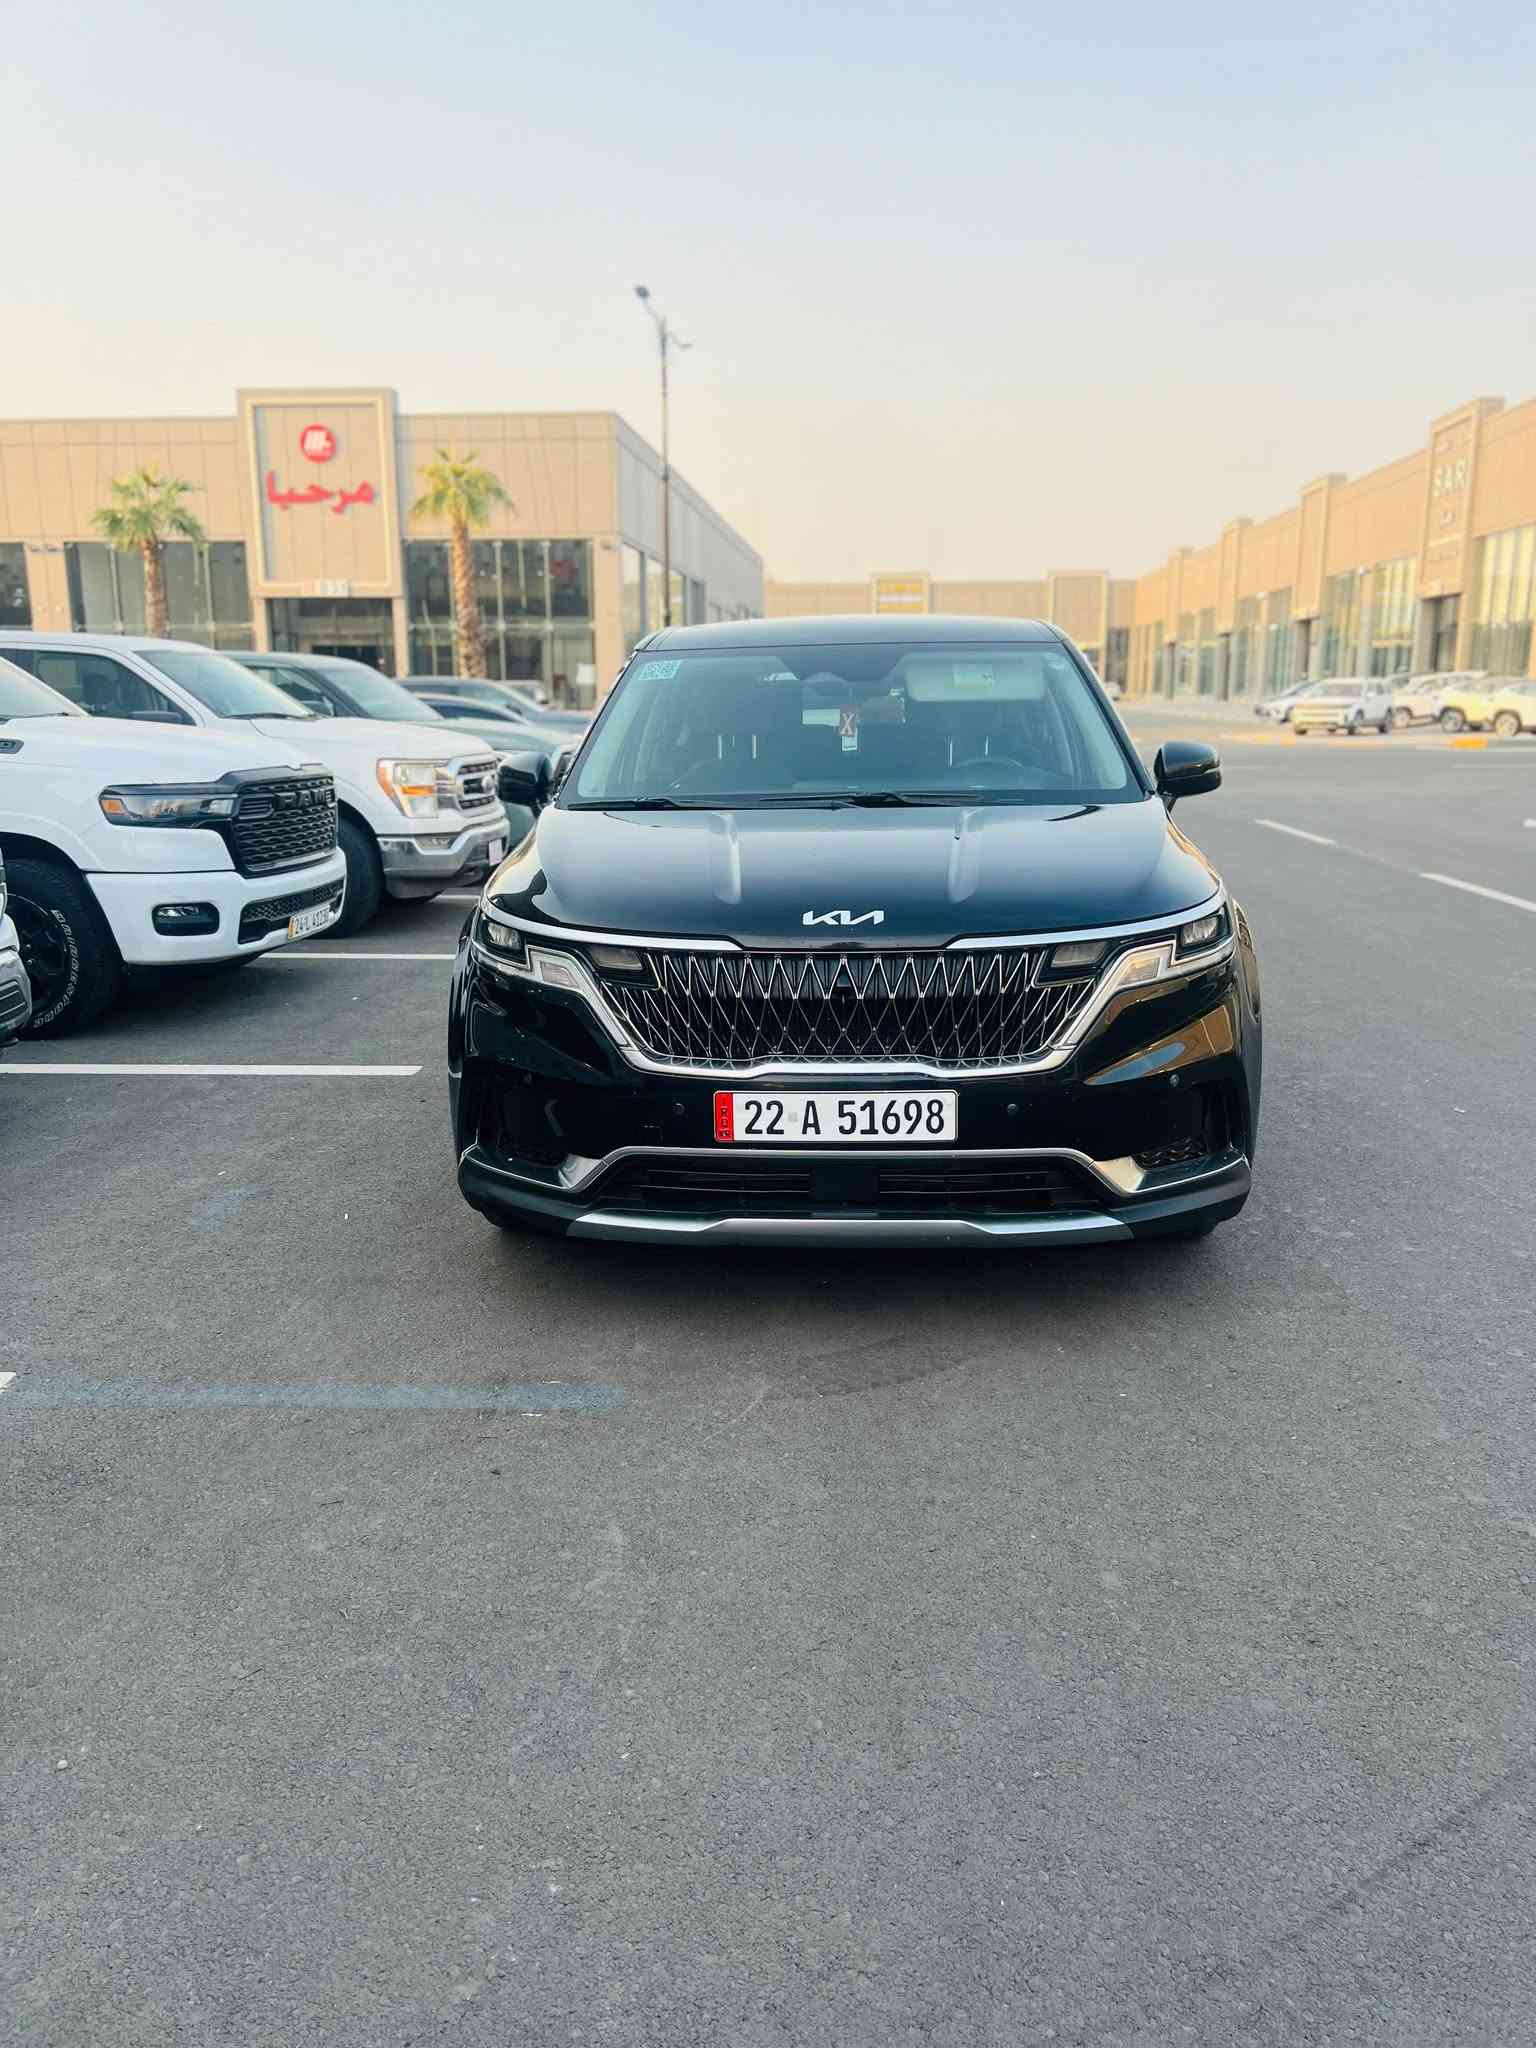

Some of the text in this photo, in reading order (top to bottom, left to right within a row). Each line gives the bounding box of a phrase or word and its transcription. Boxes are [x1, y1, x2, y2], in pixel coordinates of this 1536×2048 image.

[266, 470, 374, 514] مرحبا
[802, 910, 884, 925] KIA
[744, 1098, 944, 1135] 22 A 51698
